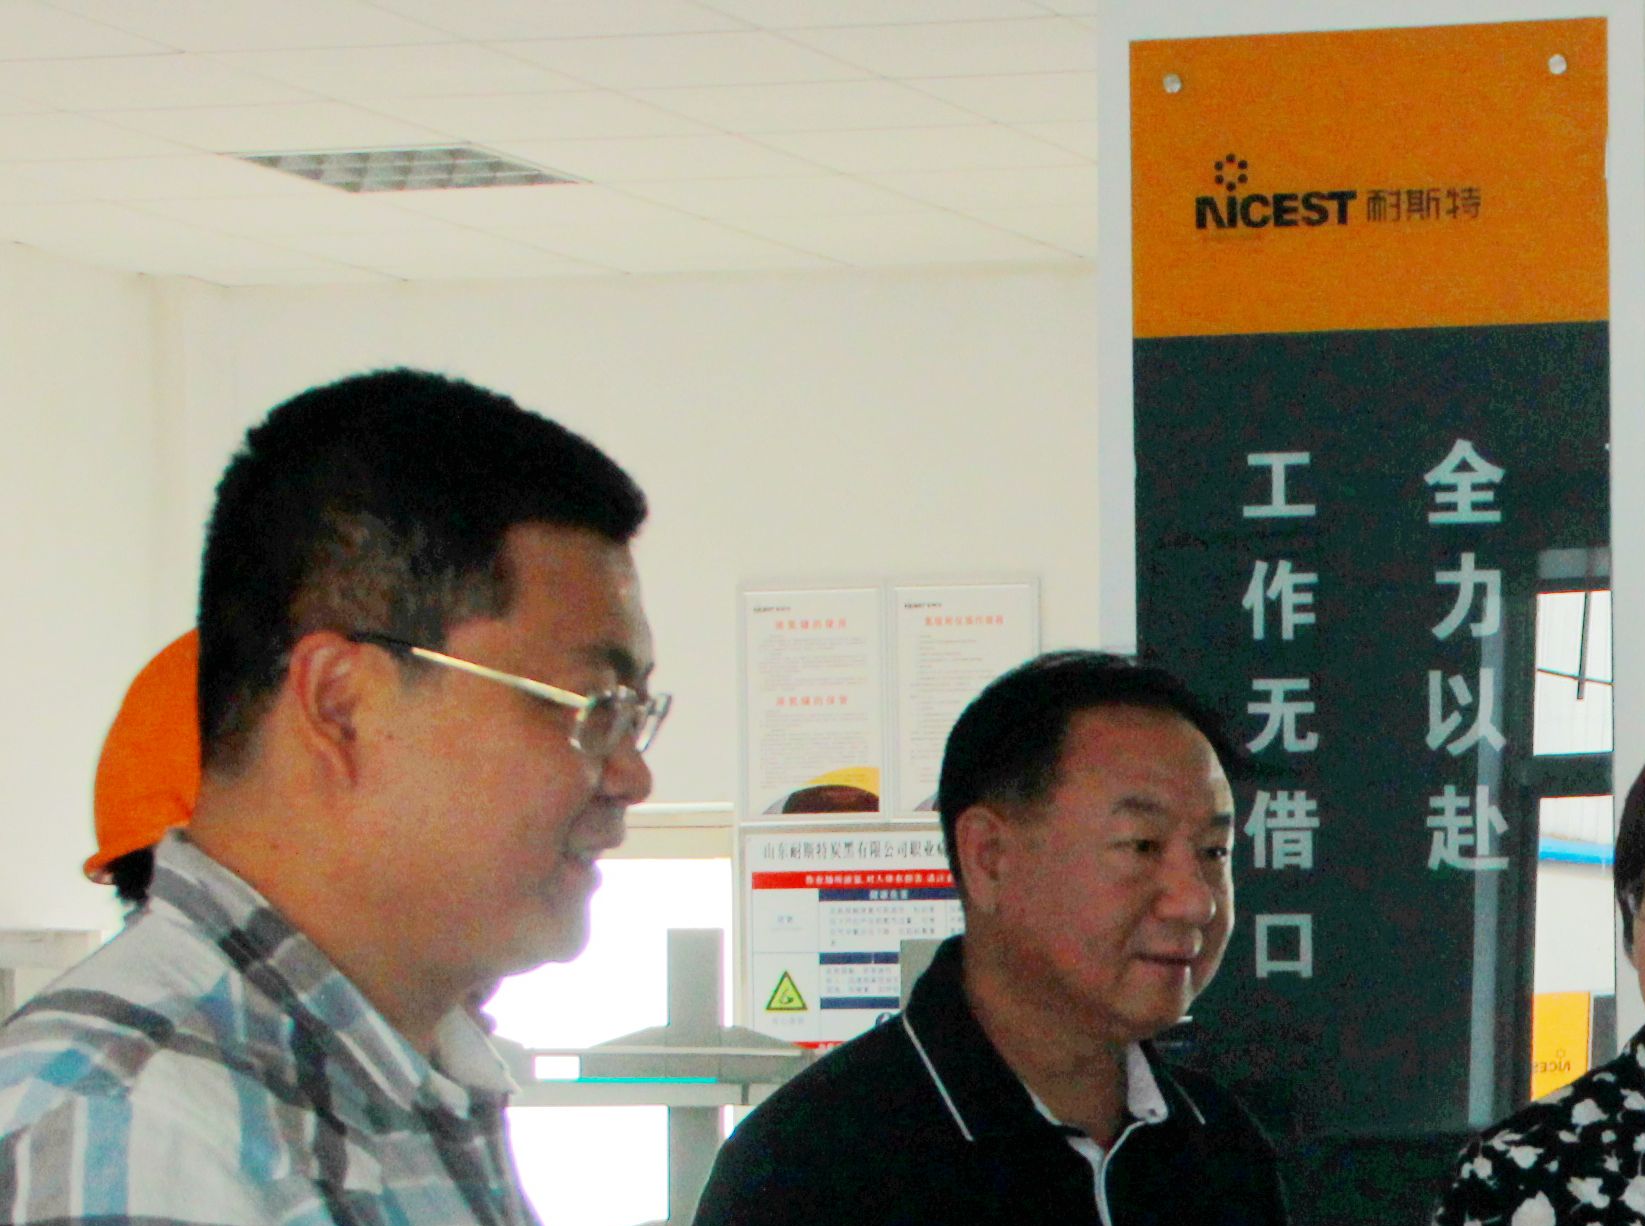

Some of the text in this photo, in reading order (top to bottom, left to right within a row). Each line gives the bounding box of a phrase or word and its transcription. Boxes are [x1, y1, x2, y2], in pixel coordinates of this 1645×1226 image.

[1366, 187, 1482, 223] 耐斯特
[1243, 452, 1320, 979] 工作无借口
[1424, 438, 1509, 871] 全力以赴
